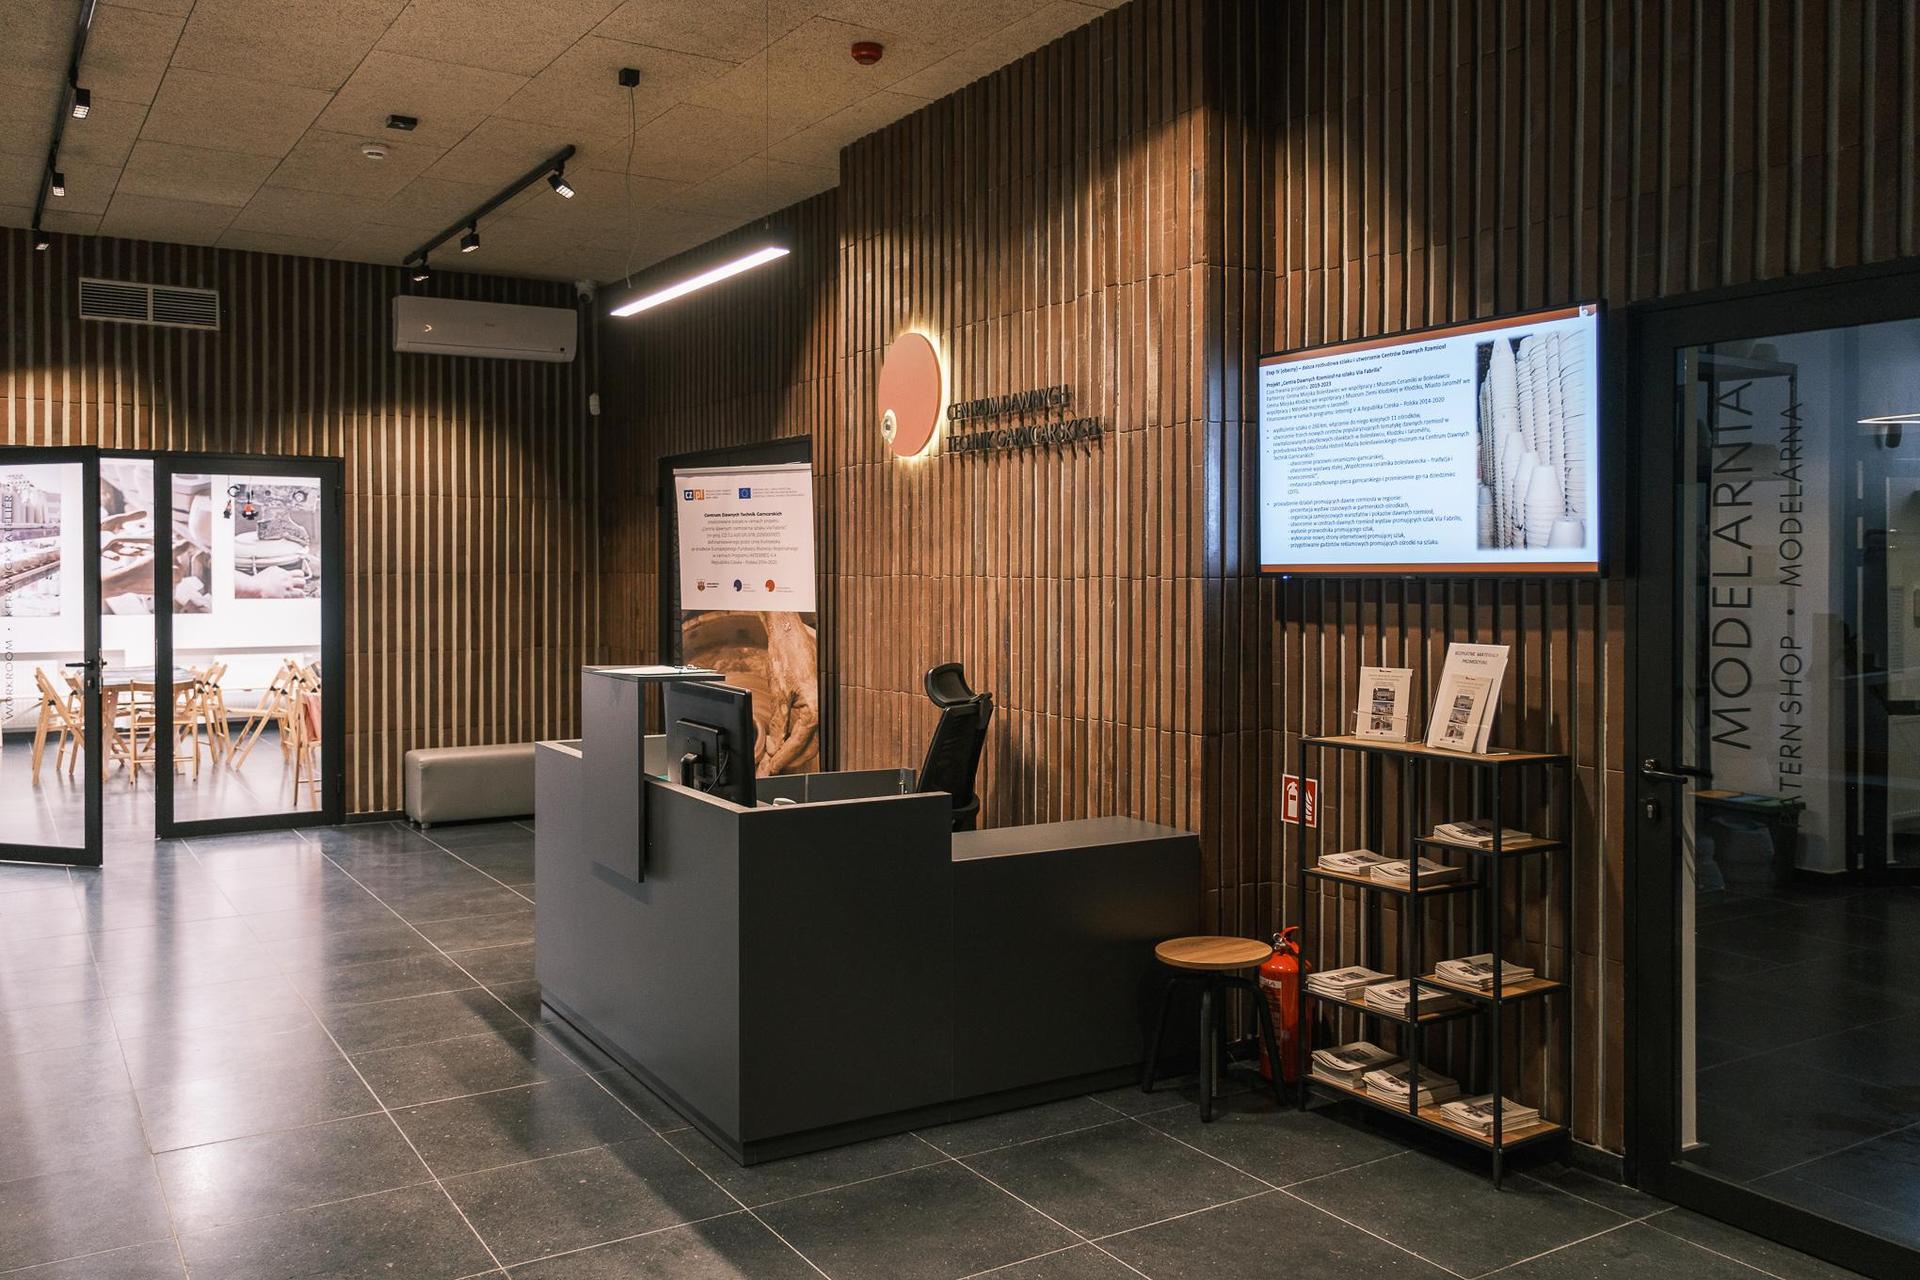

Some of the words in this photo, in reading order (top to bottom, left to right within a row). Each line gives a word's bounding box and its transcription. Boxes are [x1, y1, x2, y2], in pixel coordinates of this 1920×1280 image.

[946, 431, 995, 452] TECHNIK
[996, 417, 1103, 449] GARNCARSKICH
[947, 396, 1000, 421] CENTRUM
[1001, 384, 1069, 412] DAWNYCH
[1772, 402, 1803, 587] MODELÁRNA
[1713, 381, 1752, 749] MODELARNIA
[5, 640, 14, 719] WORKROOM
[1780, 635, 1803, 714] SHOP
